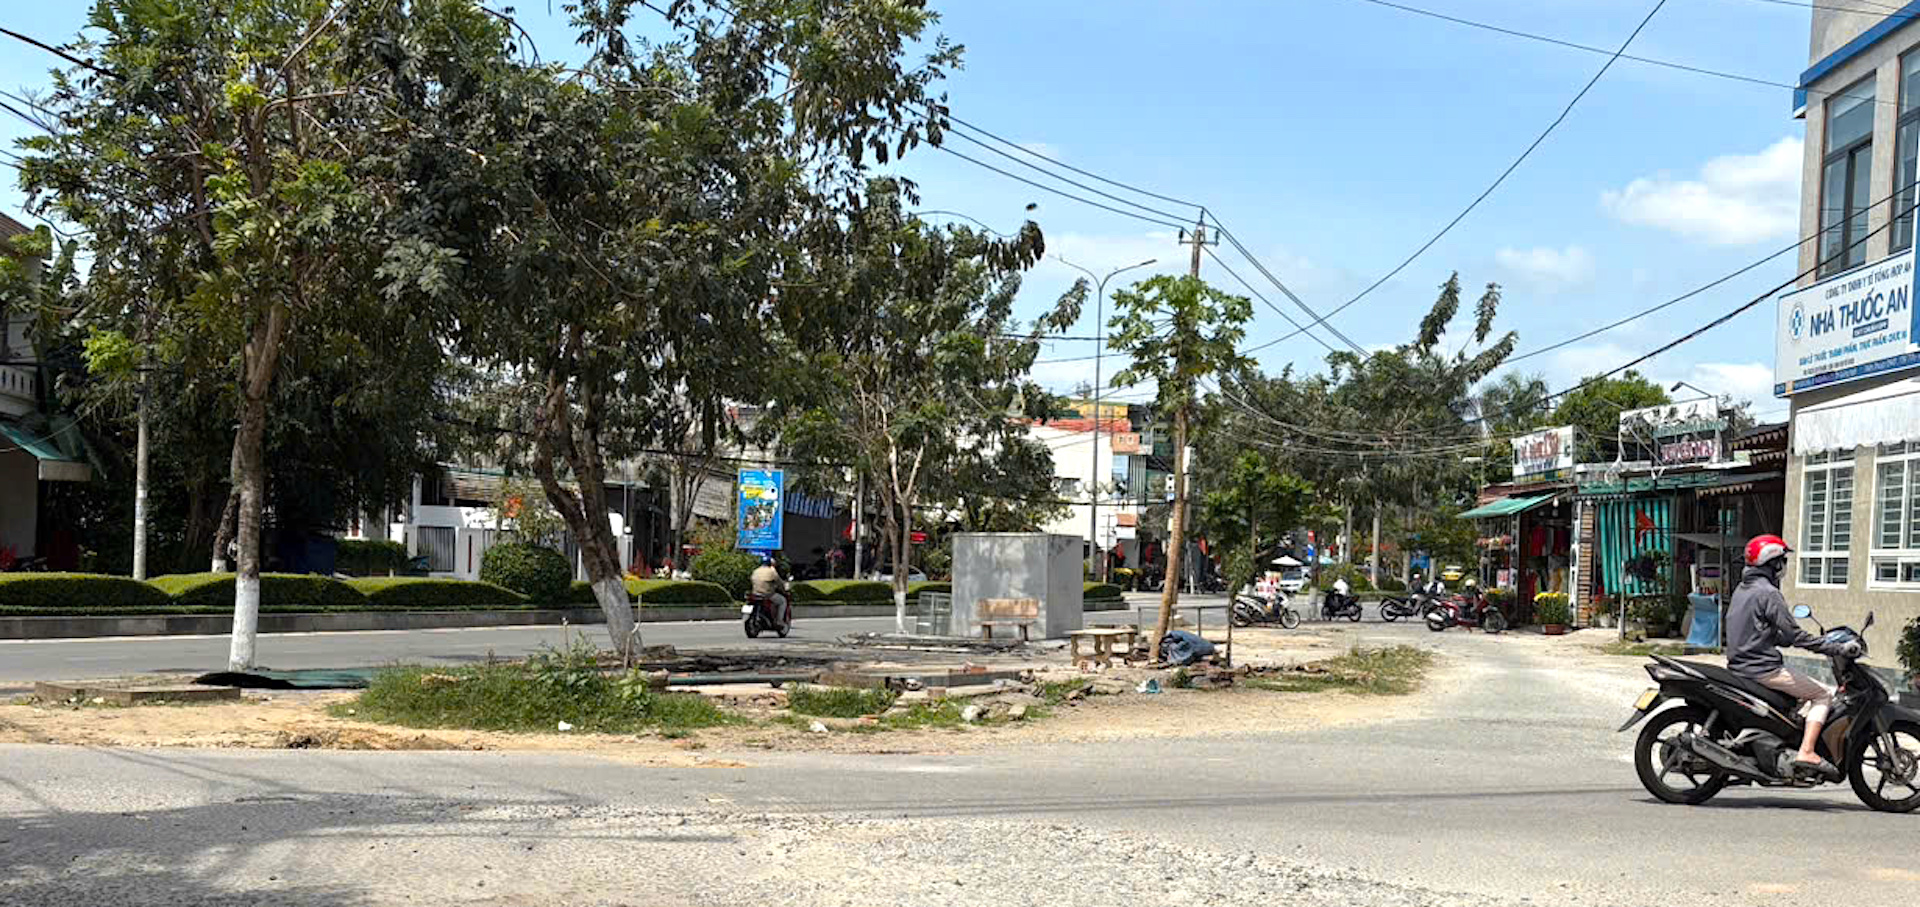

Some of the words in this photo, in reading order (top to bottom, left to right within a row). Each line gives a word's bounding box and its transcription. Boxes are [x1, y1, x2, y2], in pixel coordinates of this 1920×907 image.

[1810, 304, 1835, 338] NHÀ
[1839, 287, 1884, 330] THUỐC
[1886, 284, 1908, 315] AN
